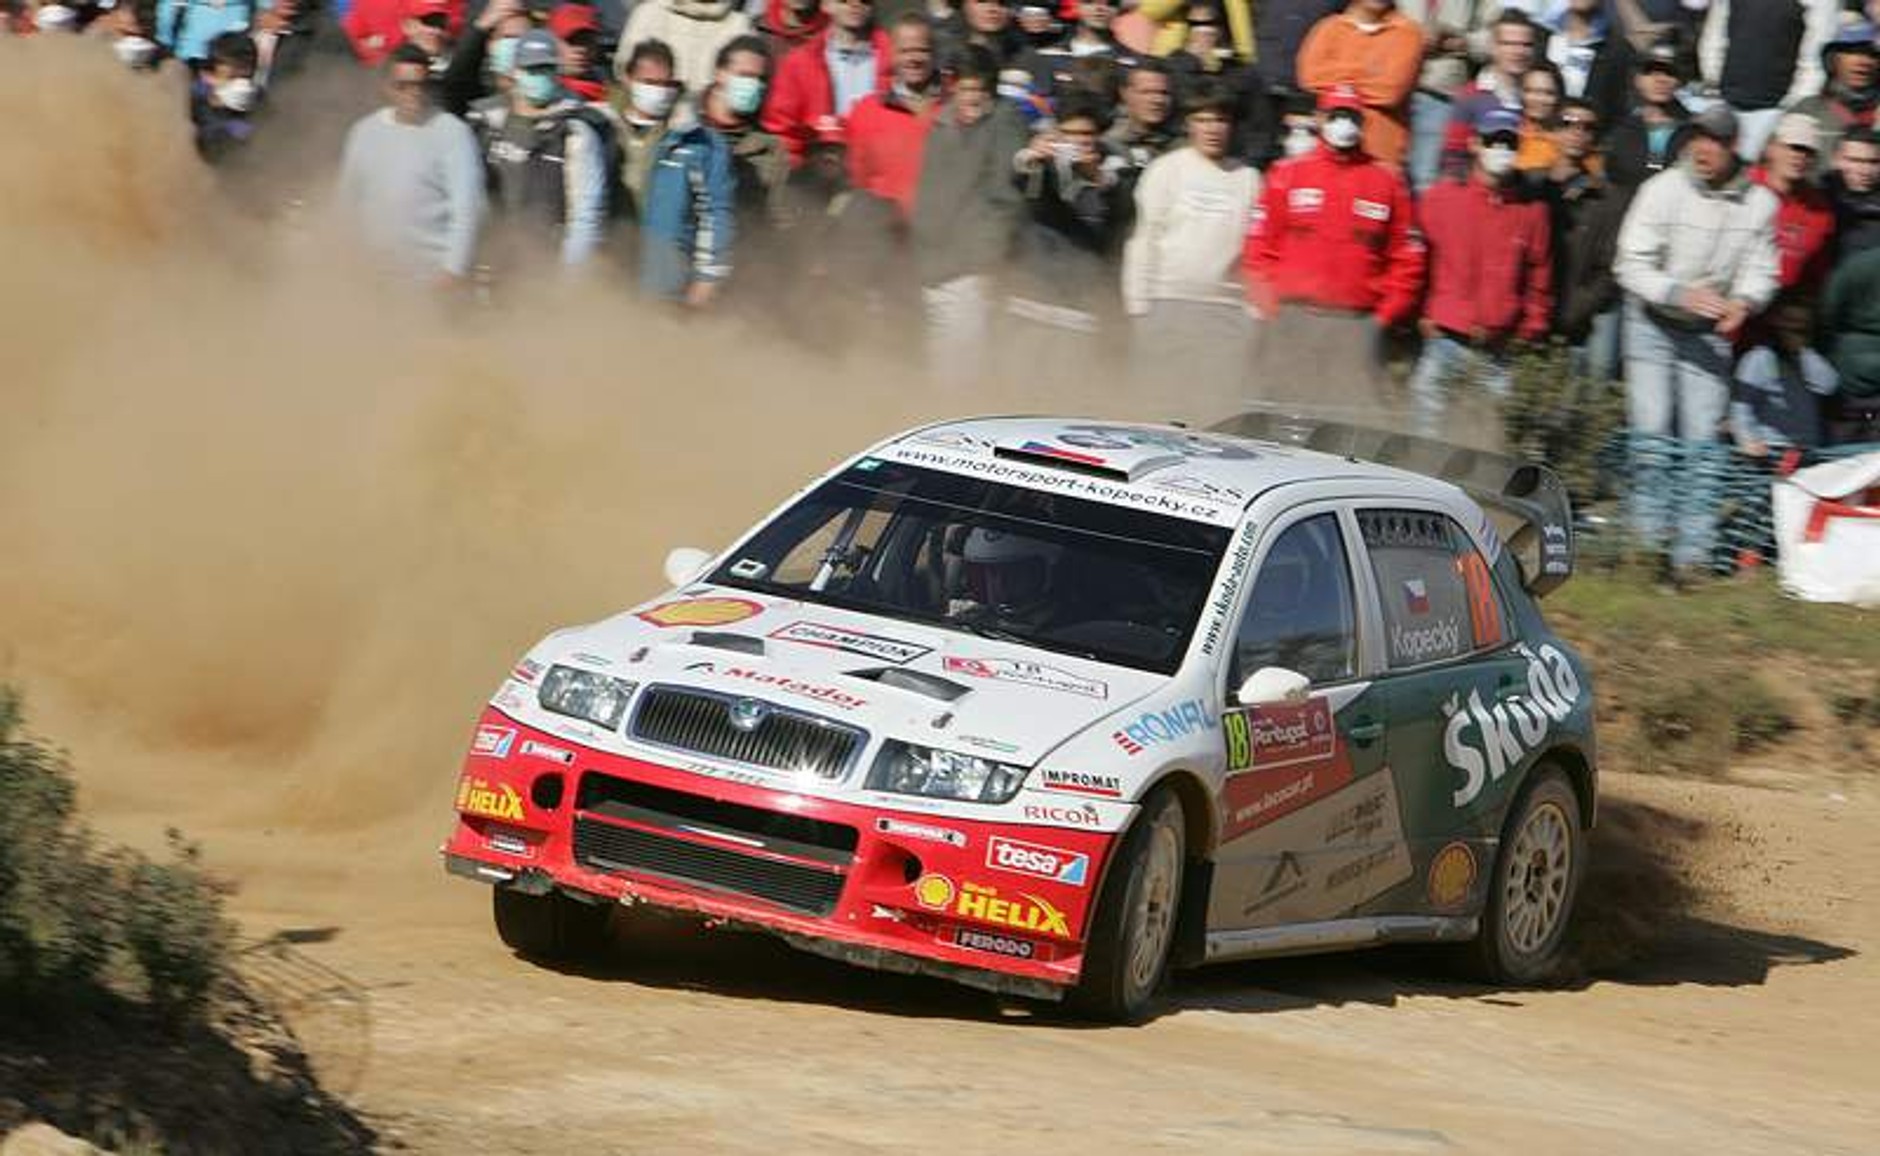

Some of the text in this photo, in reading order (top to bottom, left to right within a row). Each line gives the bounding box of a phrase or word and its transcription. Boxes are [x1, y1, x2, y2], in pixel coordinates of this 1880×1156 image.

[895, 449, 1220, 519] www.motorsport-kopecky.cz
[789, 626, 917, 658] CHAMPION
[723, 666, 868, 708] Matador
[1126, 697, 1219, 747] RONAL
[1223, 712, 1250, 770] 18
[1041, 769, 1121, 790] IMPROMAT
[466, 783, 526, 822] HELIX
[1023, 804, 1101, 826] RICOH
[995, 842, 1059, 874] tesa
[957, 890, 1071, 937] HELIX
[960, 928, 1032, 957] FERODO
